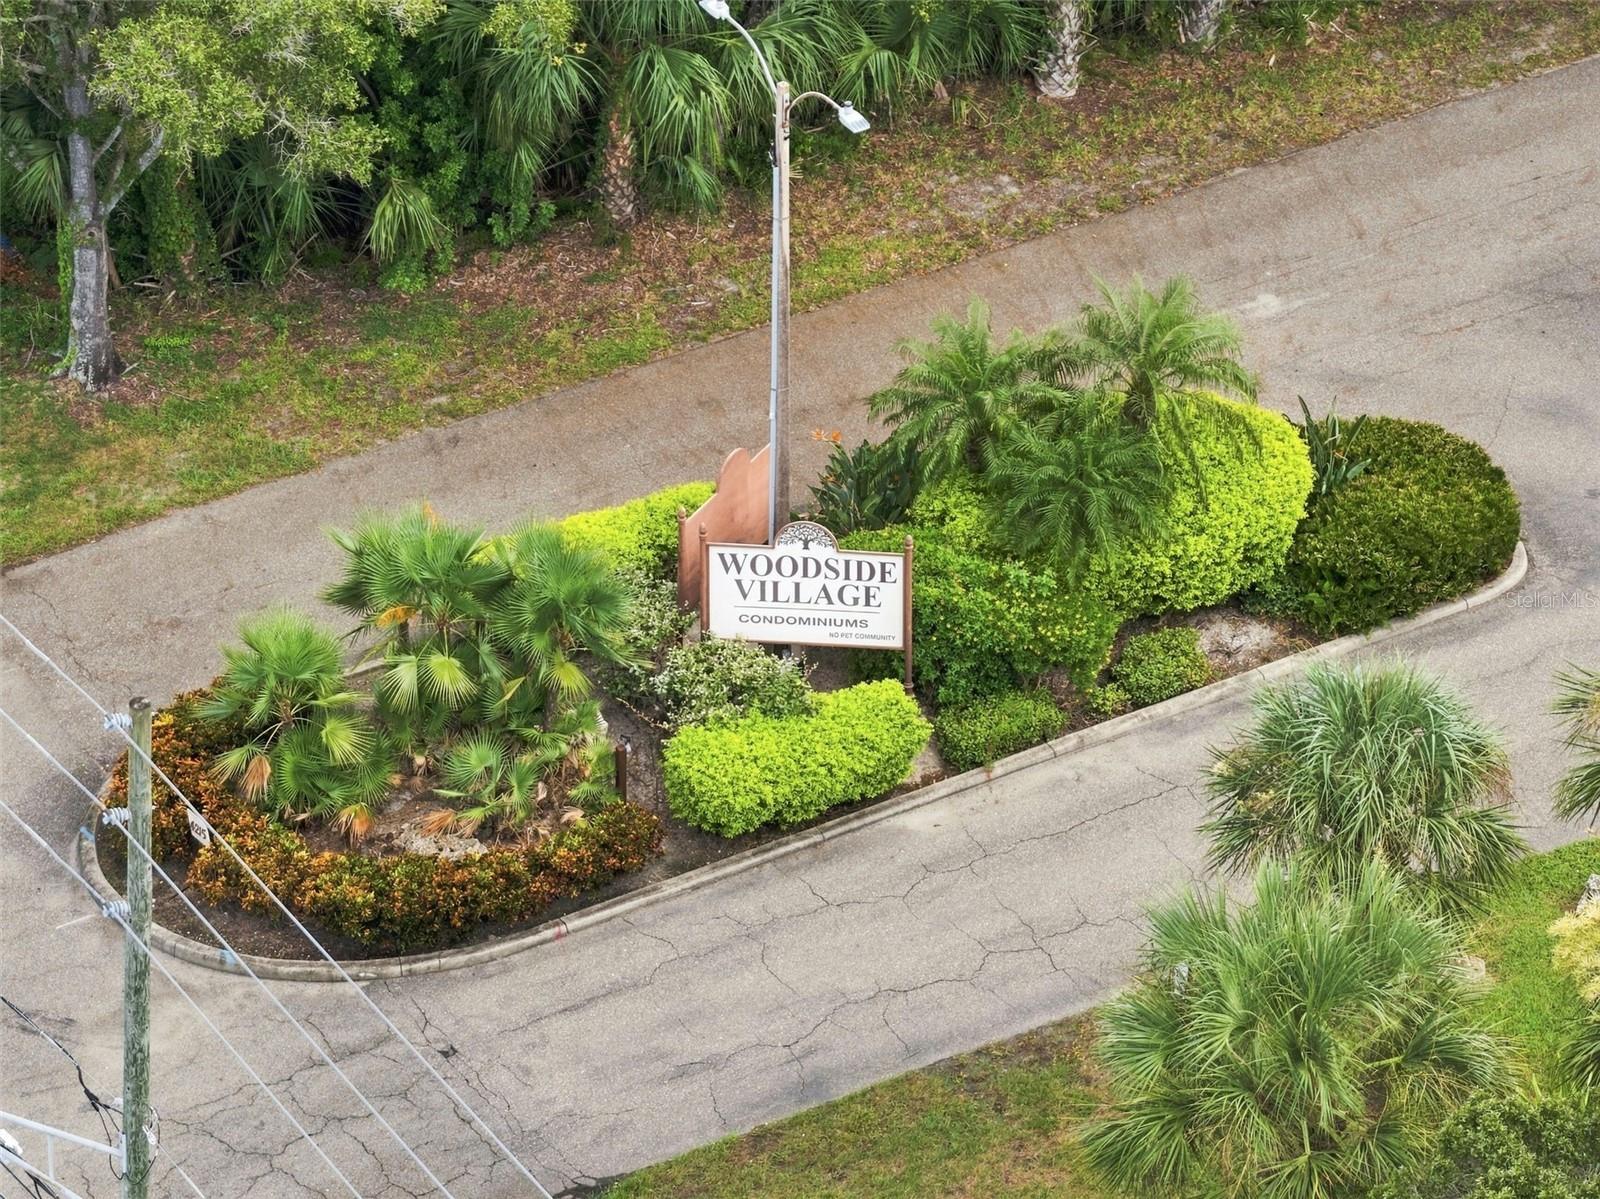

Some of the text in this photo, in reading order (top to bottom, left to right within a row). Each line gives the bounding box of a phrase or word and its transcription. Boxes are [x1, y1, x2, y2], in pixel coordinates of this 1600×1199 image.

[718, 553, 897, 584] WOODSIDE
[734, 579, 882, 608] VILLAGE
[738, 614, 869, 629] CONDOMINIUMS
[841, 632, 853, 640] PET
[854, 633, 896, 641] COMMUNITY
